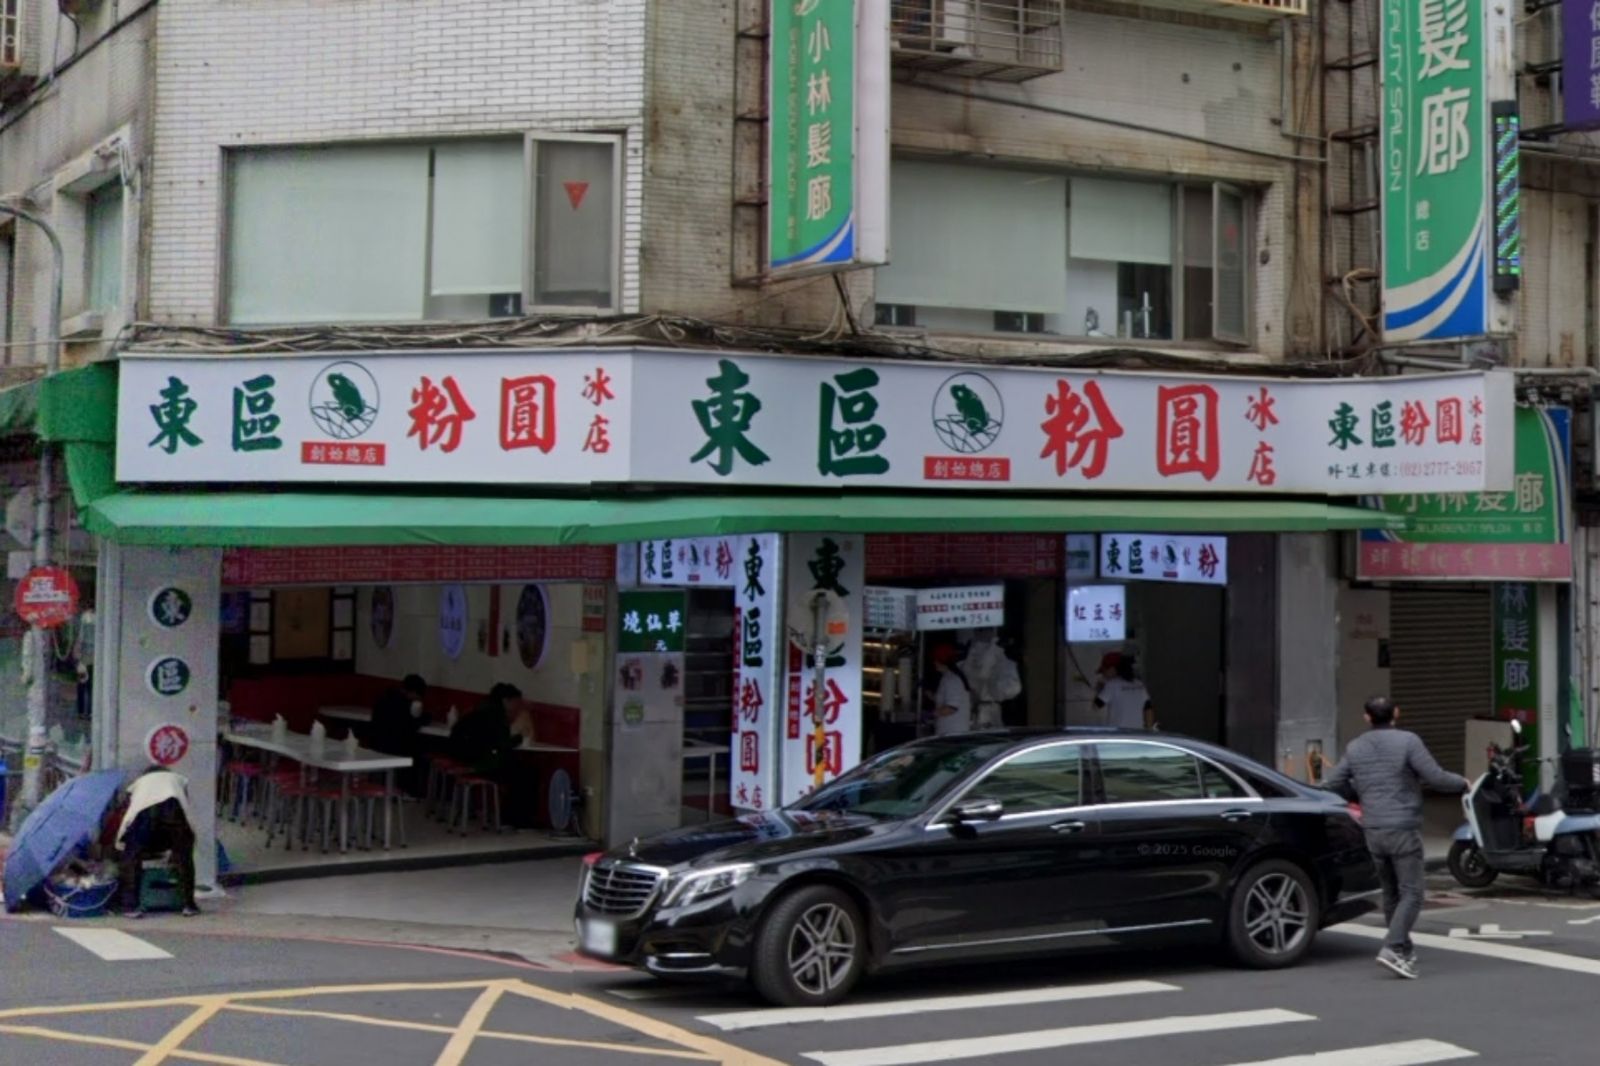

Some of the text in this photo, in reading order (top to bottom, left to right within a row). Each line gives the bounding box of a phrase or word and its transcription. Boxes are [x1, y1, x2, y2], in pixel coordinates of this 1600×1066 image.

[806, 20, 831, 221] 小林髮廊
[1418, 0, 1470, 177] 髮廊
[1390, 87, 1403, 191] SALON
[148, 374, 557, 455] 東區 粉圓
[309, 444, 378, 464] 創始總店
[581, 367, 615, 454] 冰店
[690, 359, 1220, 481] 東區 粉圓
[1245, 386, 1280, 487] 冰店
[1328, 398, 1462, 450] 東區粉圓
[1469, 395, 1483, 446] 冰店
[932, 462, 1002, 478] 創始總店
[1106, 538, 1144, 574] 東區
[1198, 543, 1220, 578] 粉
[740, 538, 765, 775] 東區粉圓
